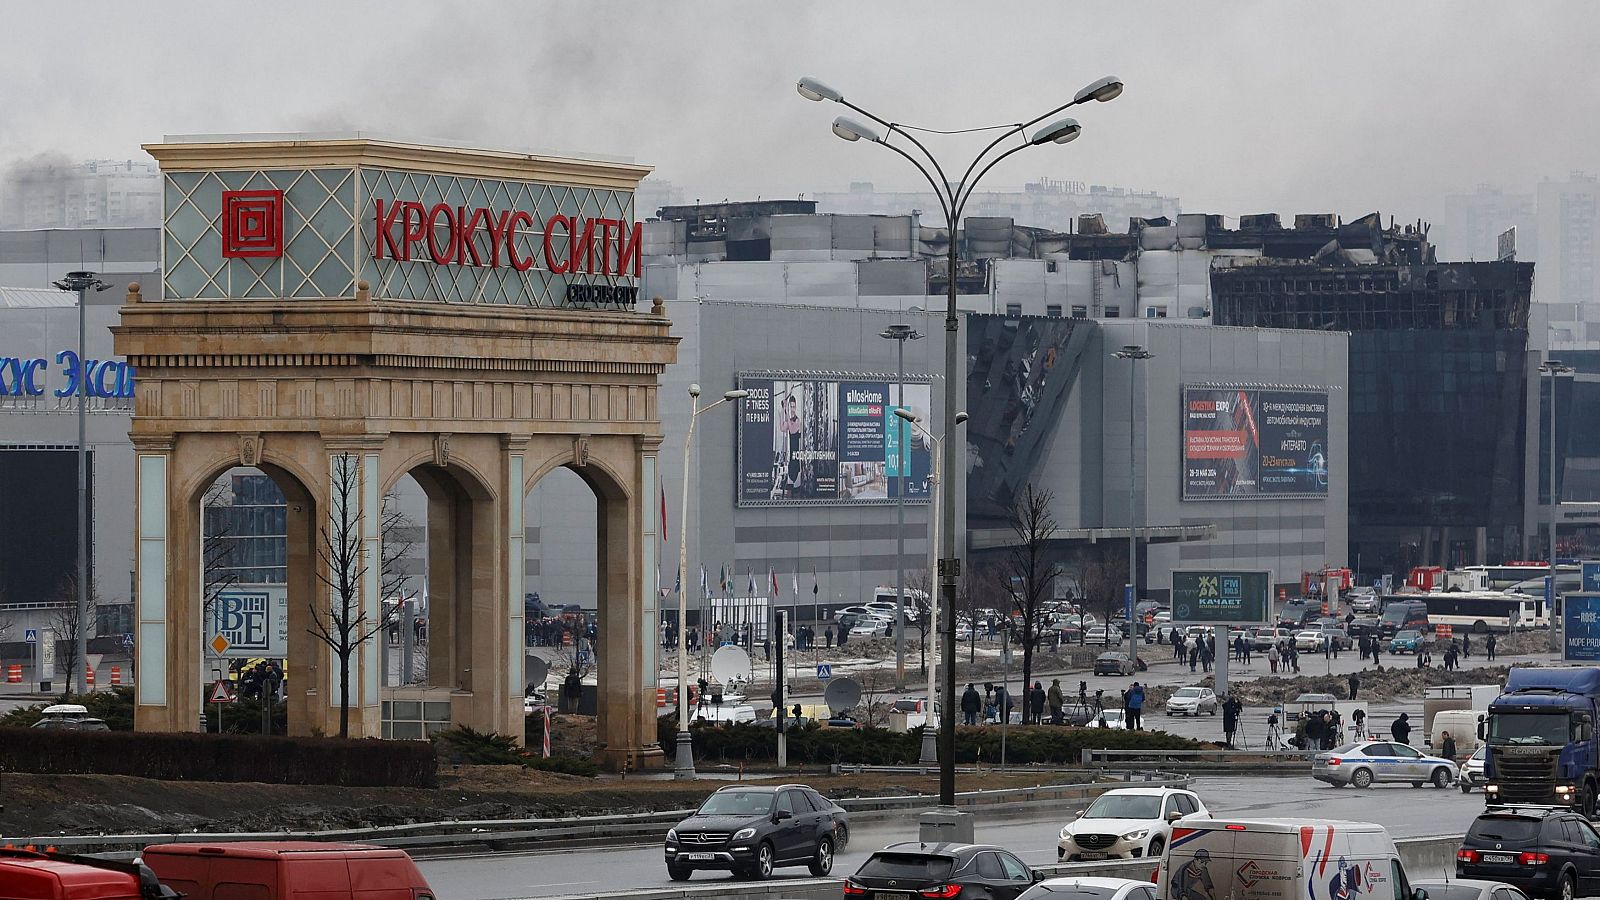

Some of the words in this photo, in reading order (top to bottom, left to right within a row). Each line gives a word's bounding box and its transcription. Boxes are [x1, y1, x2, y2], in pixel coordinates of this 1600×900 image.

[375, 198, 533, 272] КРОКУС
[544, 213, 643, 278] СИТИ
[566, 284, 613, 304] CROCUS
[613, 286, 640, 304] CITY
[851, 389, 882, 403] MosHome
[746, 411, 770, 423] ПЕРВЫЙ
[1223, 579, 1239, 588] FM
[1586, 637, 1600, 649] РЯД
[1509, 747, 1542, 755] SCANIA
